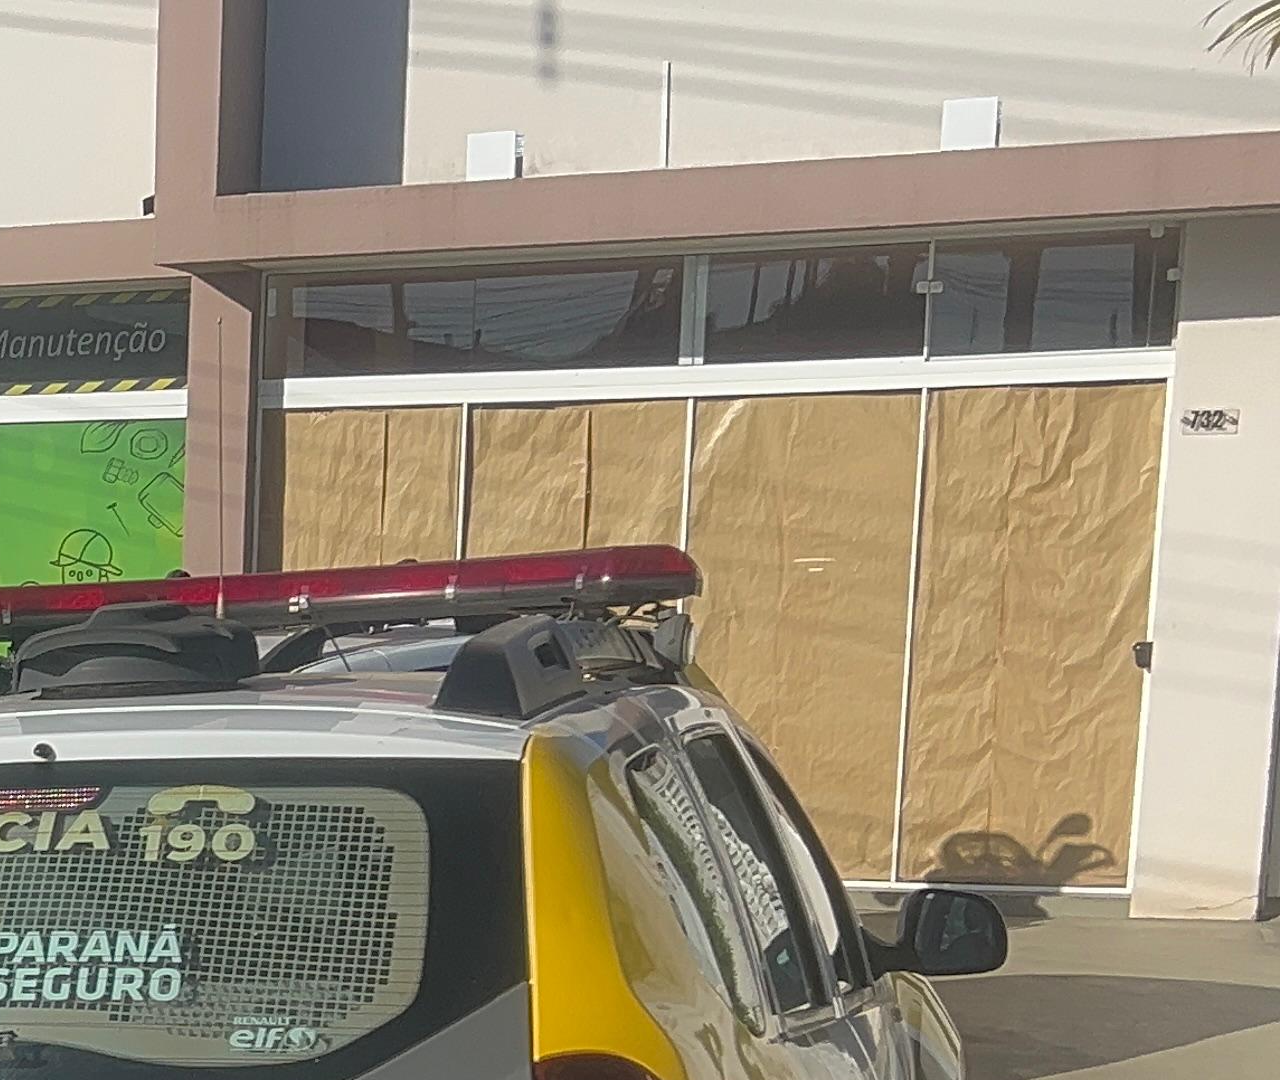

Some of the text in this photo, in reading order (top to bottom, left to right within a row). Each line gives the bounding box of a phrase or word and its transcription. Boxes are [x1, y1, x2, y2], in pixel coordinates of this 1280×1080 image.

[1190, 409, 1225, 430] 732
[139, 823, 256, 862] 190
[232, 1016, 293, 1025] RENAULT
[229, 1027, 286, 1049] elf
